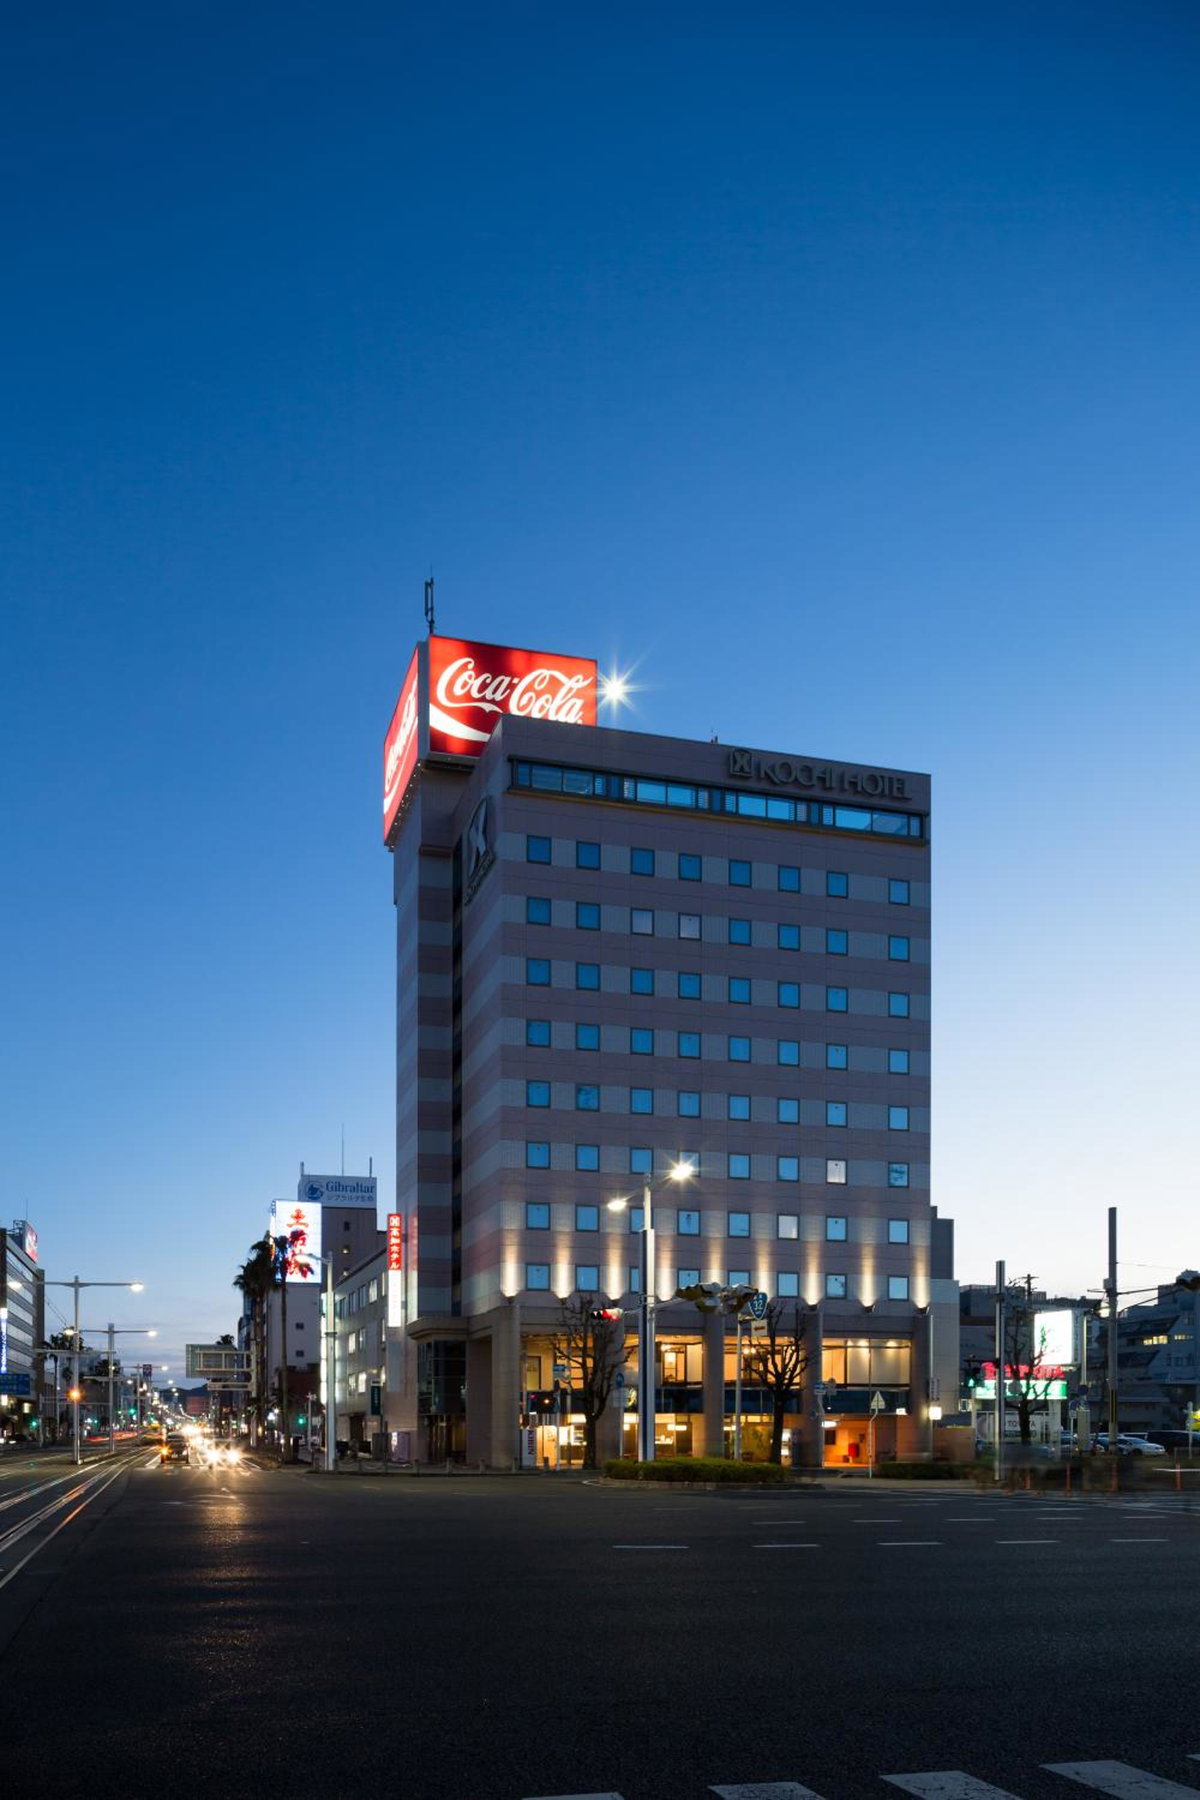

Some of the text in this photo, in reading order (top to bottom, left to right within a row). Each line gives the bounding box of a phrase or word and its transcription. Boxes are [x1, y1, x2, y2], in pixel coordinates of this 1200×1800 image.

[437, 657, 593, 724] Coca-Cola
[759, 758, 912, 800] KOCHI HOTEL
[325, 1181, 375, 1194] Gibraltar
